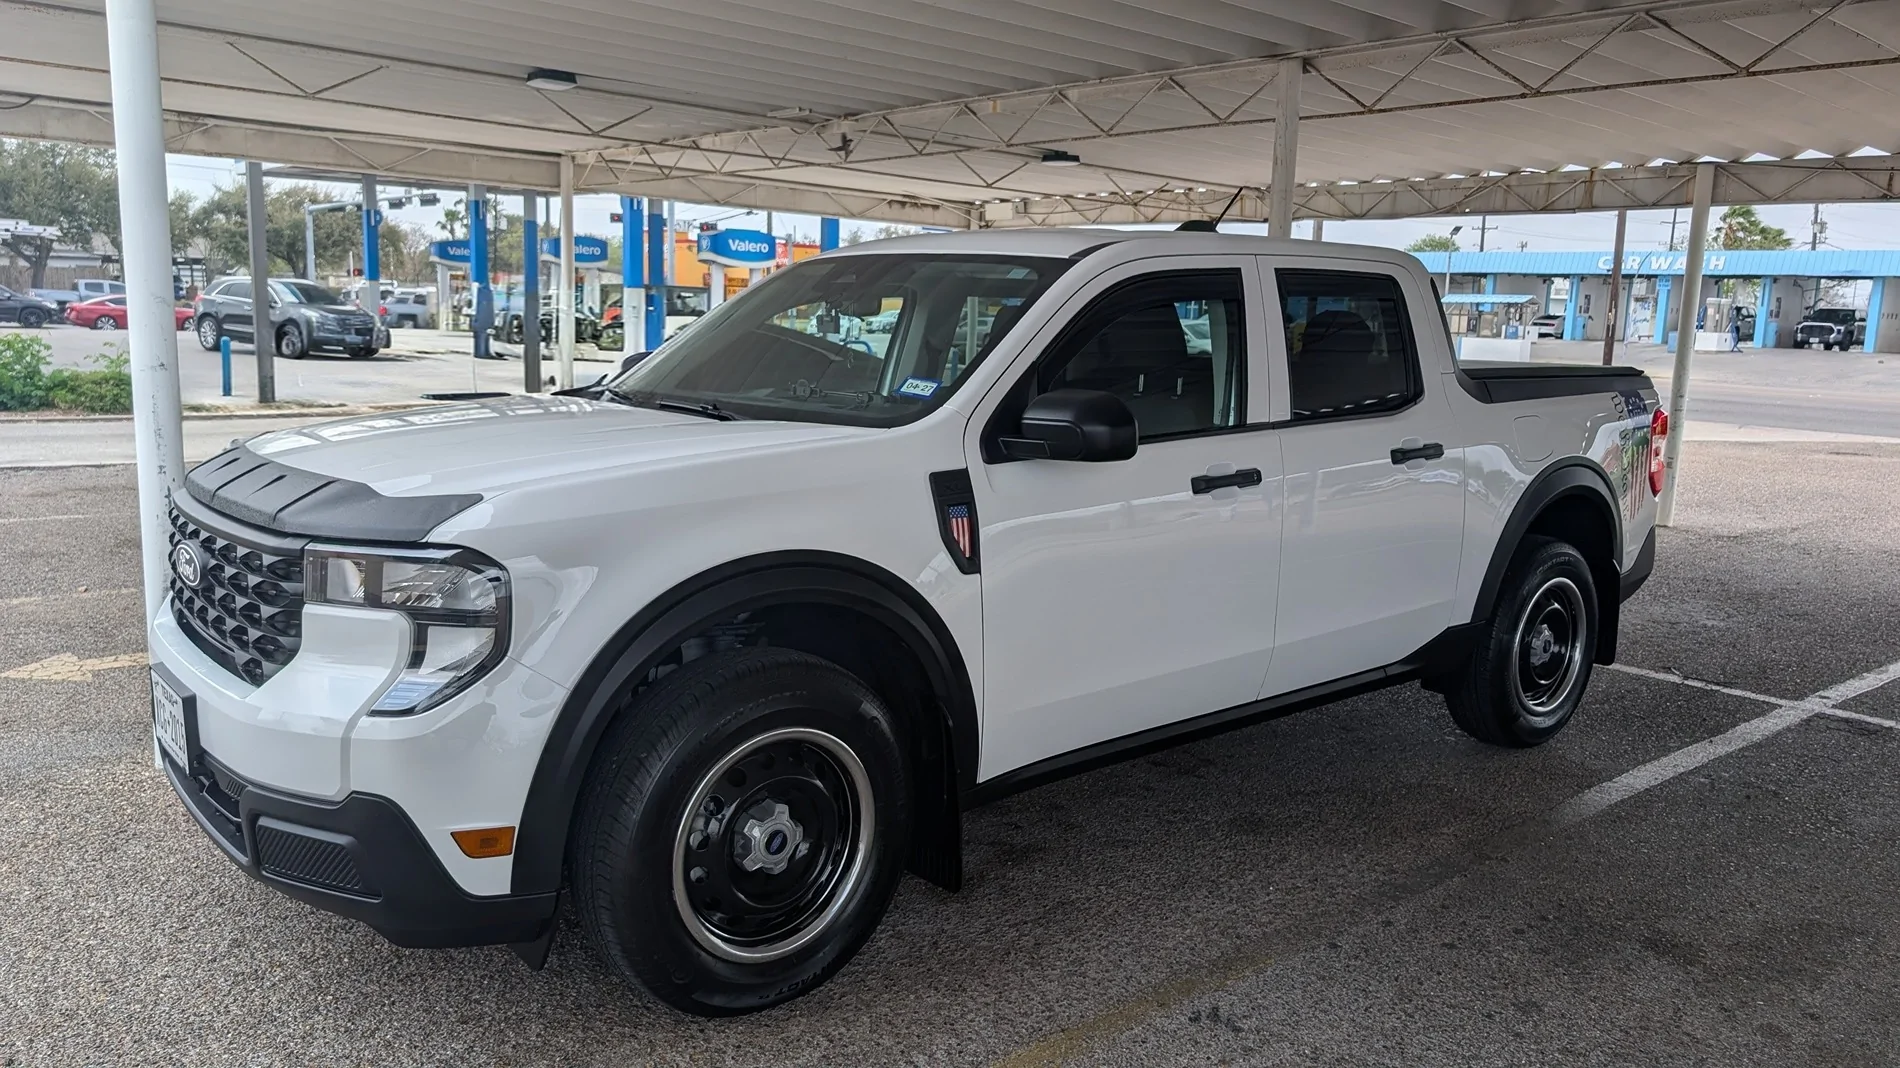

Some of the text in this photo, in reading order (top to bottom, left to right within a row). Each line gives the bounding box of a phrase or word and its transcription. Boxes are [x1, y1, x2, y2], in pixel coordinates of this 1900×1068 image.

[447, 246, 471, 256] Vale
[728, 239, 769, 253] Valero
[1597, 255, 1727, 271] CR WAH
[178, 548, 196, 582] Ford
